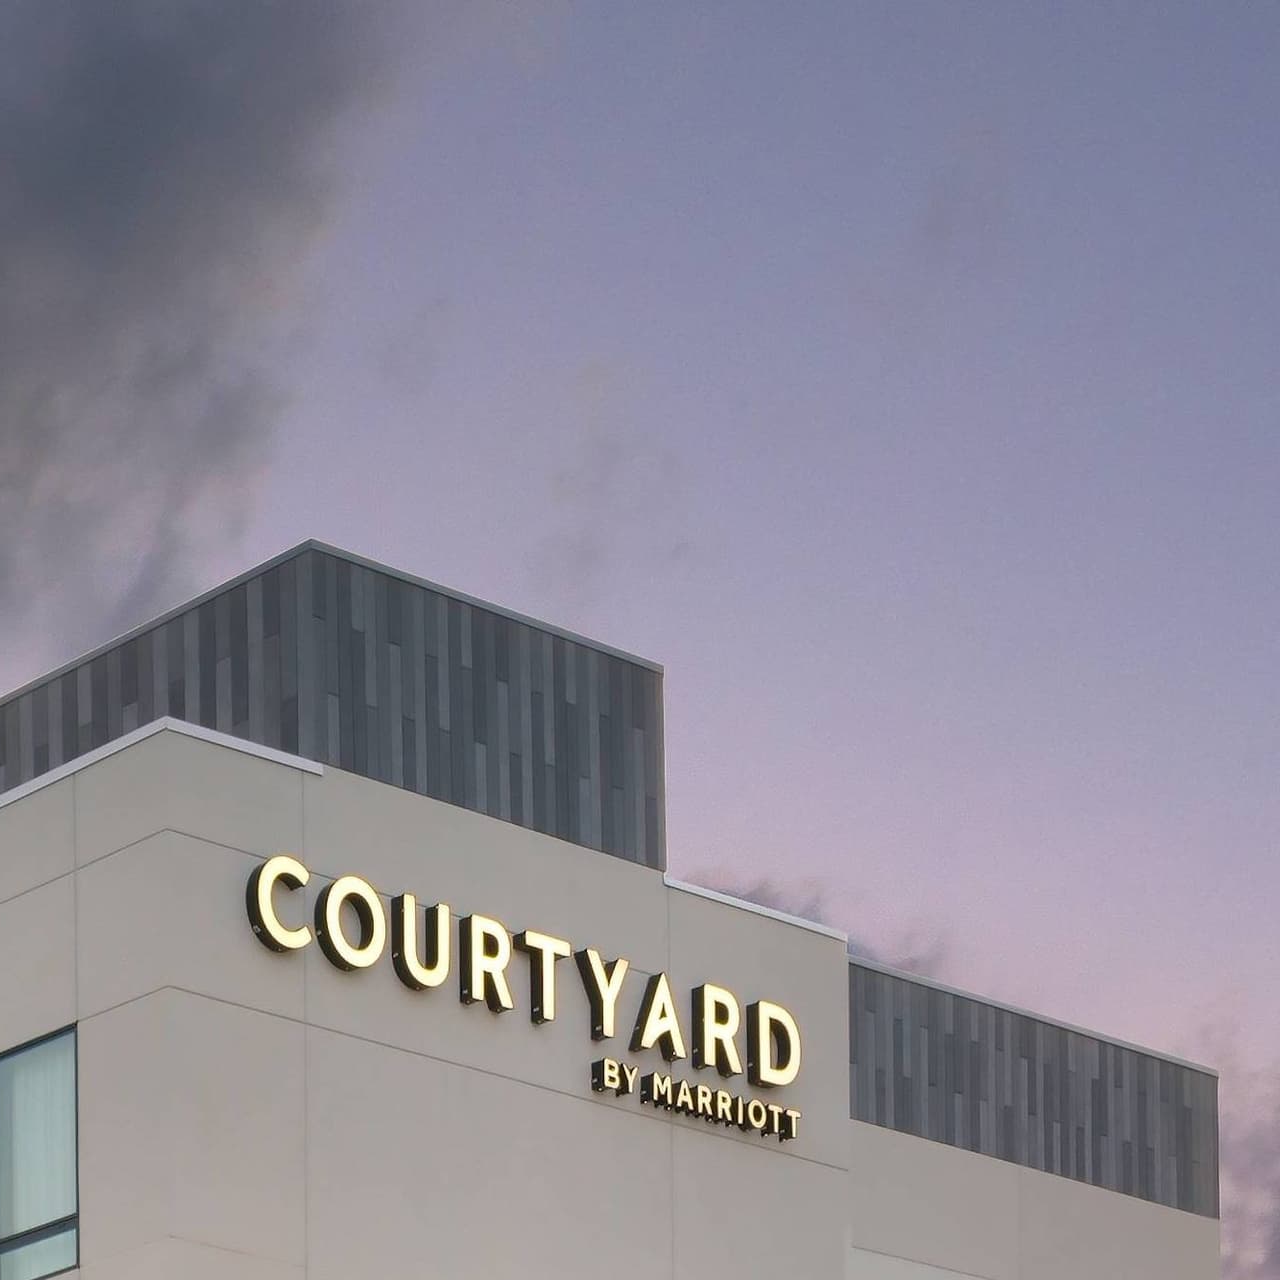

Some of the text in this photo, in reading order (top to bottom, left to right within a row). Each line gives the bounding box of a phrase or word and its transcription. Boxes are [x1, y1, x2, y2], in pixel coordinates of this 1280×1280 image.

[247, 854, 802, 1088] COURTYARD
[594, 1057, 802, 1141] BY MARRIOTT
